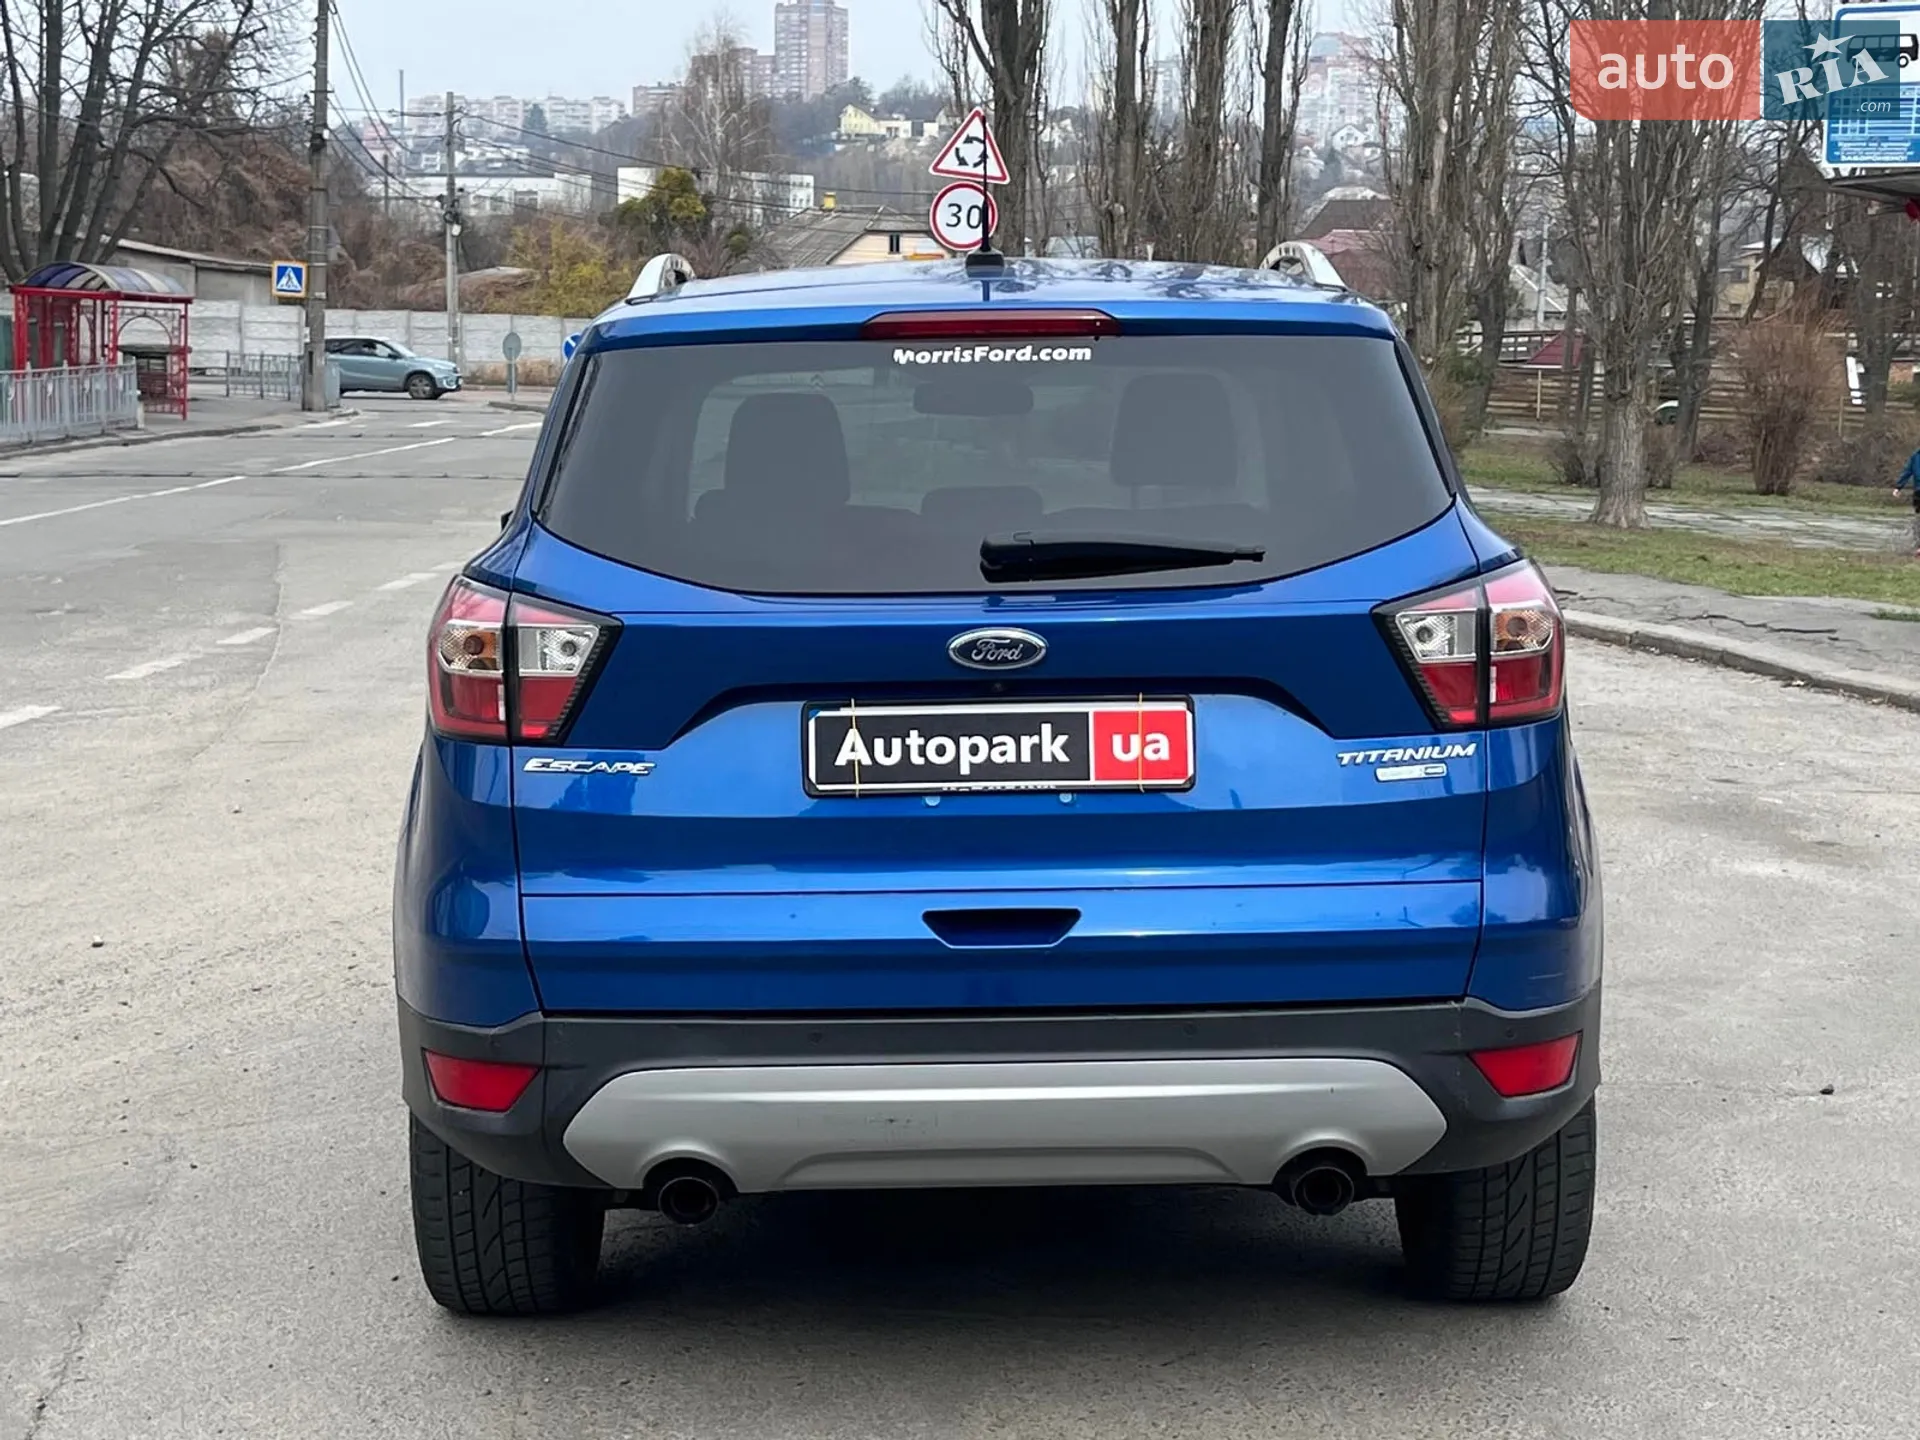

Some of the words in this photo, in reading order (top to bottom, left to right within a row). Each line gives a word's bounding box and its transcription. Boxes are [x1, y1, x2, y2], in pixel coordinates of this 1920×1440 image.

[946, 203, 984, 229] 30
[970, 638, 1023, 662] Ford
[834, 723, 1070, 775] Autopark
[1112, 733, 1170, 762] ua
[1337, 743, 1478, 766] TITANIUM
[523, 757, 656, 775] ESCAPE
